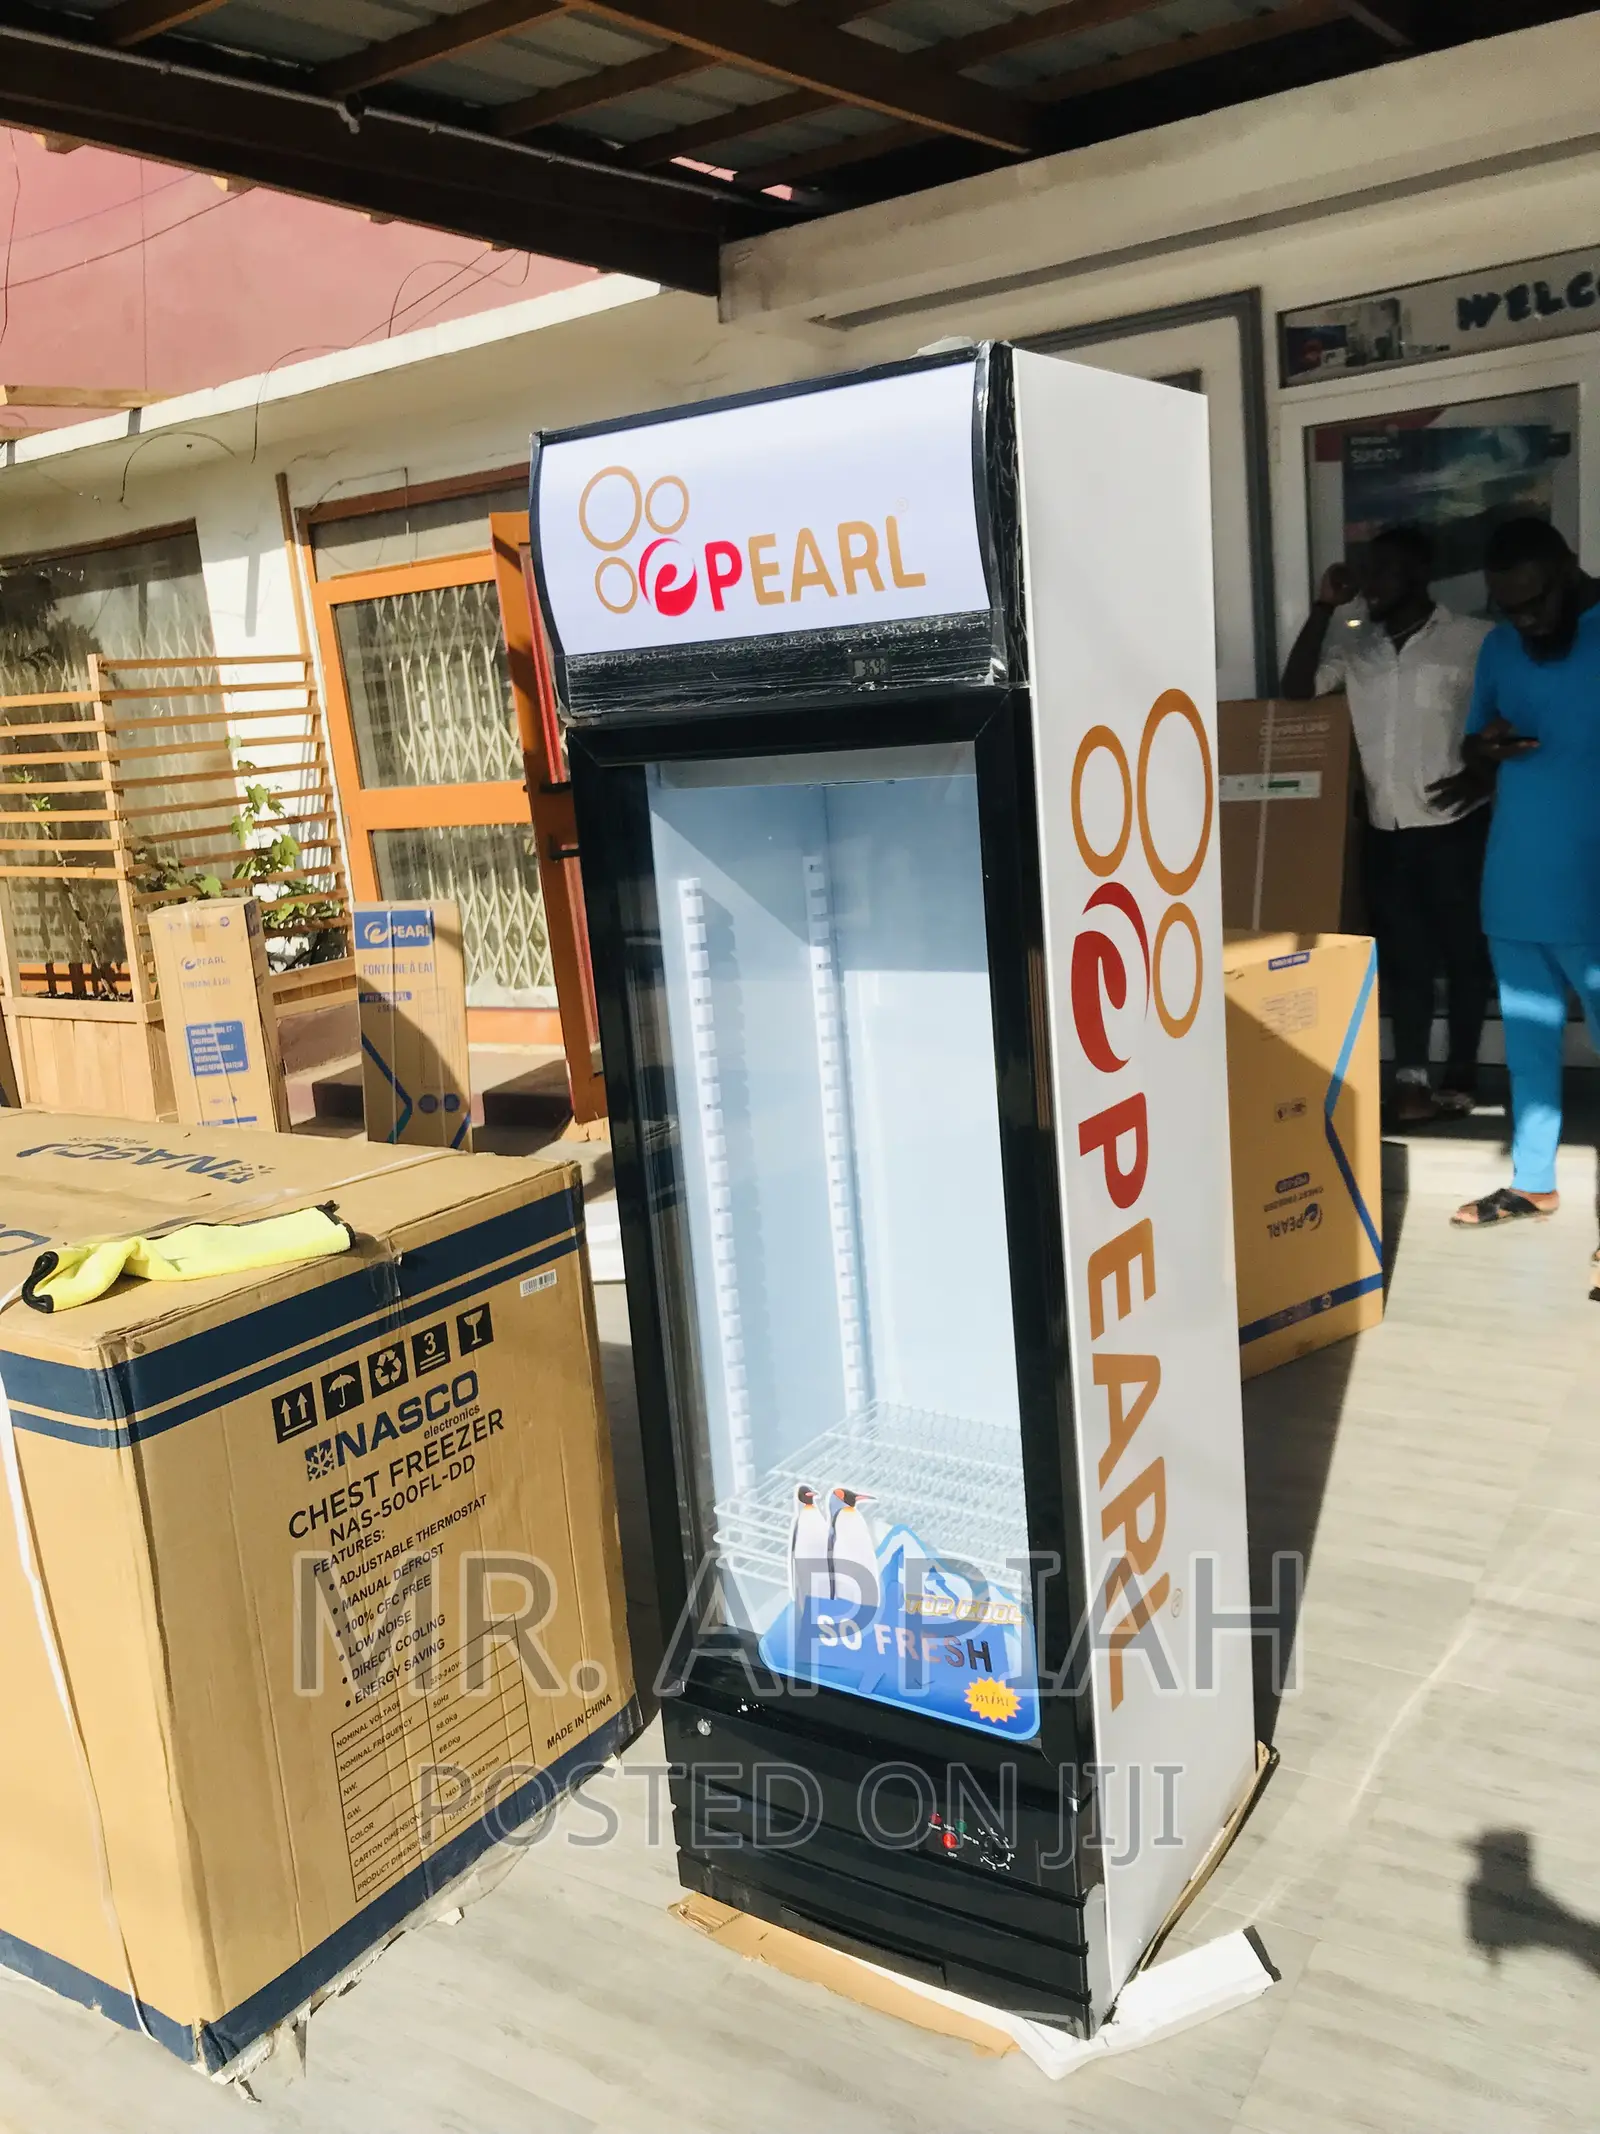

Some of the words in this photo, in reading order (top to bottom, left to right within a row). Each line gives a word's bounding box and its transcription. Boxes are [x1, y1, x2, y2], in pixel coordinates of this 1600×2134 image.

[1457, 271, 1600, 331] WELC
[704, 515, 927, 612] PEARL
[1266, 1212, 1304, 1239] PEARL
[423, 1331, 437, 1356] 3
[335, 1369, 479, 1467] NASCO
[423, 1404, 481, 1440] electronics
[1078, 1092, 1170, 1713] PEARL
[288, 1470, 380, 1539] CHEST
[388, 1408, 505, 1488] FREEZER
[329, 1454, 476, 1547] NAS-500FL-DD
[312, 1529, 386, 1577] FEATURES:
[338, 1536, 414, 1589] ADJUSTABLE
[415, 1493, 487, 1543] THERMOSTAT
[342, 1575, 391, 1613] MANUAL
[392, 1542, 445, 1582] DEFROST
[344, 1608, 375, 1634] 100%
[376, 1593, 400, 1615] CFC
[402, 1573, 432, 1601] FREE
[348, 1631, 375, 1658] LOW
[377, 1610, 413, 1640] NOISE
[351, 1645, 393, 1681] DIRECT
[395, 1613, 446, 1652] COOLING
[816, 1614, 863, 1651] SO
[873, 1623, 993, 1674] FRESH
[354, 1664, 401, 1705] ENERGY
[404, 1637, 446, 1672] SAVING
[975, 1691, 1009, 1707] mini
[335, 1722, 369, 1749] NOMINAL
[339, 1745, 372, 1773] NOMINAL
[372, 1716, 414, 1750] FREQUENCY
[546, 1721, 574, 1750] MADE
[574, 1713, 585, 1729] IN
[585, 1693, 613, 1720] CHINA
[349, 1821, 375, 1845] COLOR
[352, 1841, 383, 1868] CARTON
[356, 1861, 390, 1892] PRODUCT
